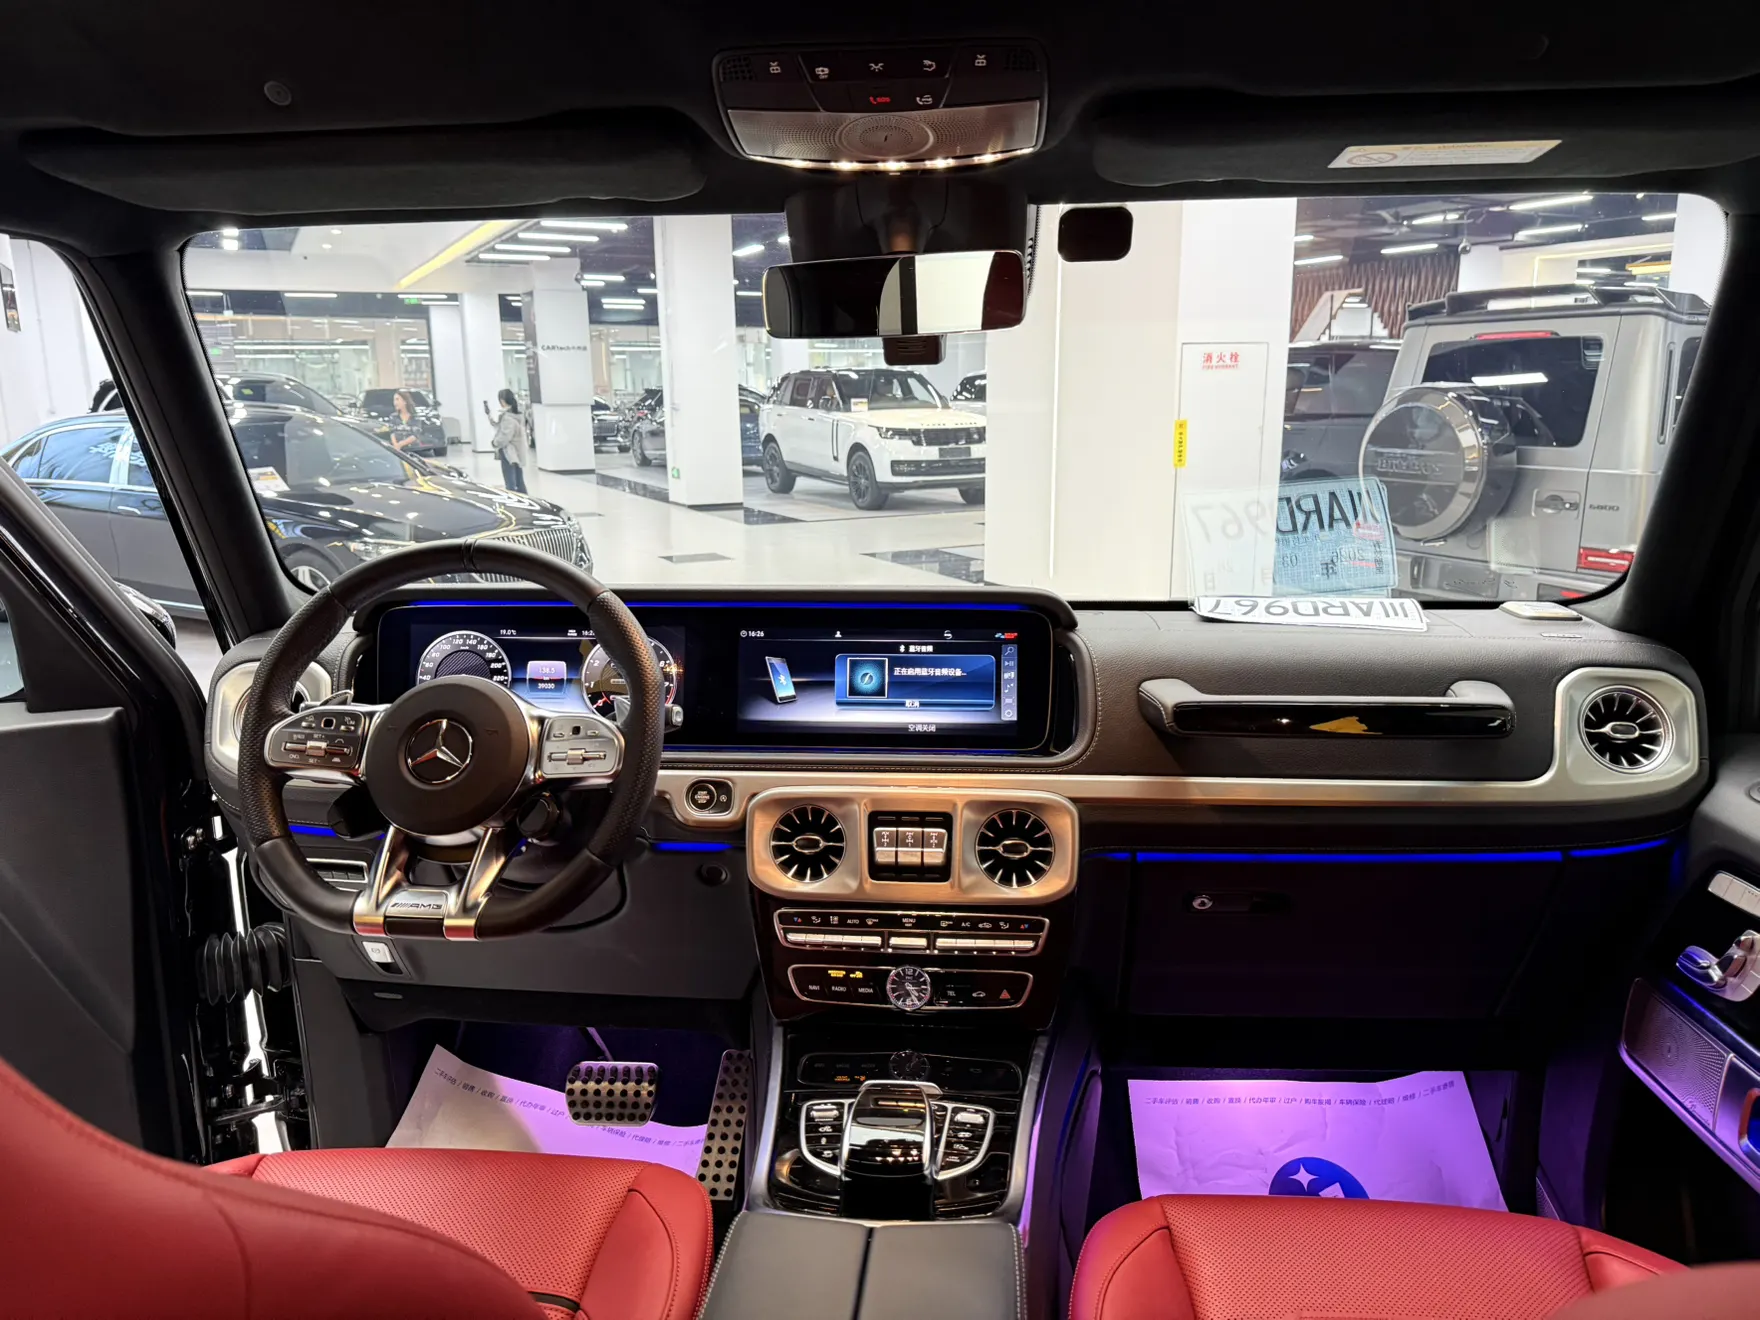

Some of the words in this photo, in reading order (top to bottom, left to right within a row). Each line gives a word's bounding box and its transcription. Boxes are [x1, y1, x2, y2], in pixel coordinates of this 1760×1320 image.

[1202, 351, 1240, 364] 消火栓
[908, 724, 937, 733] 空调关闭
